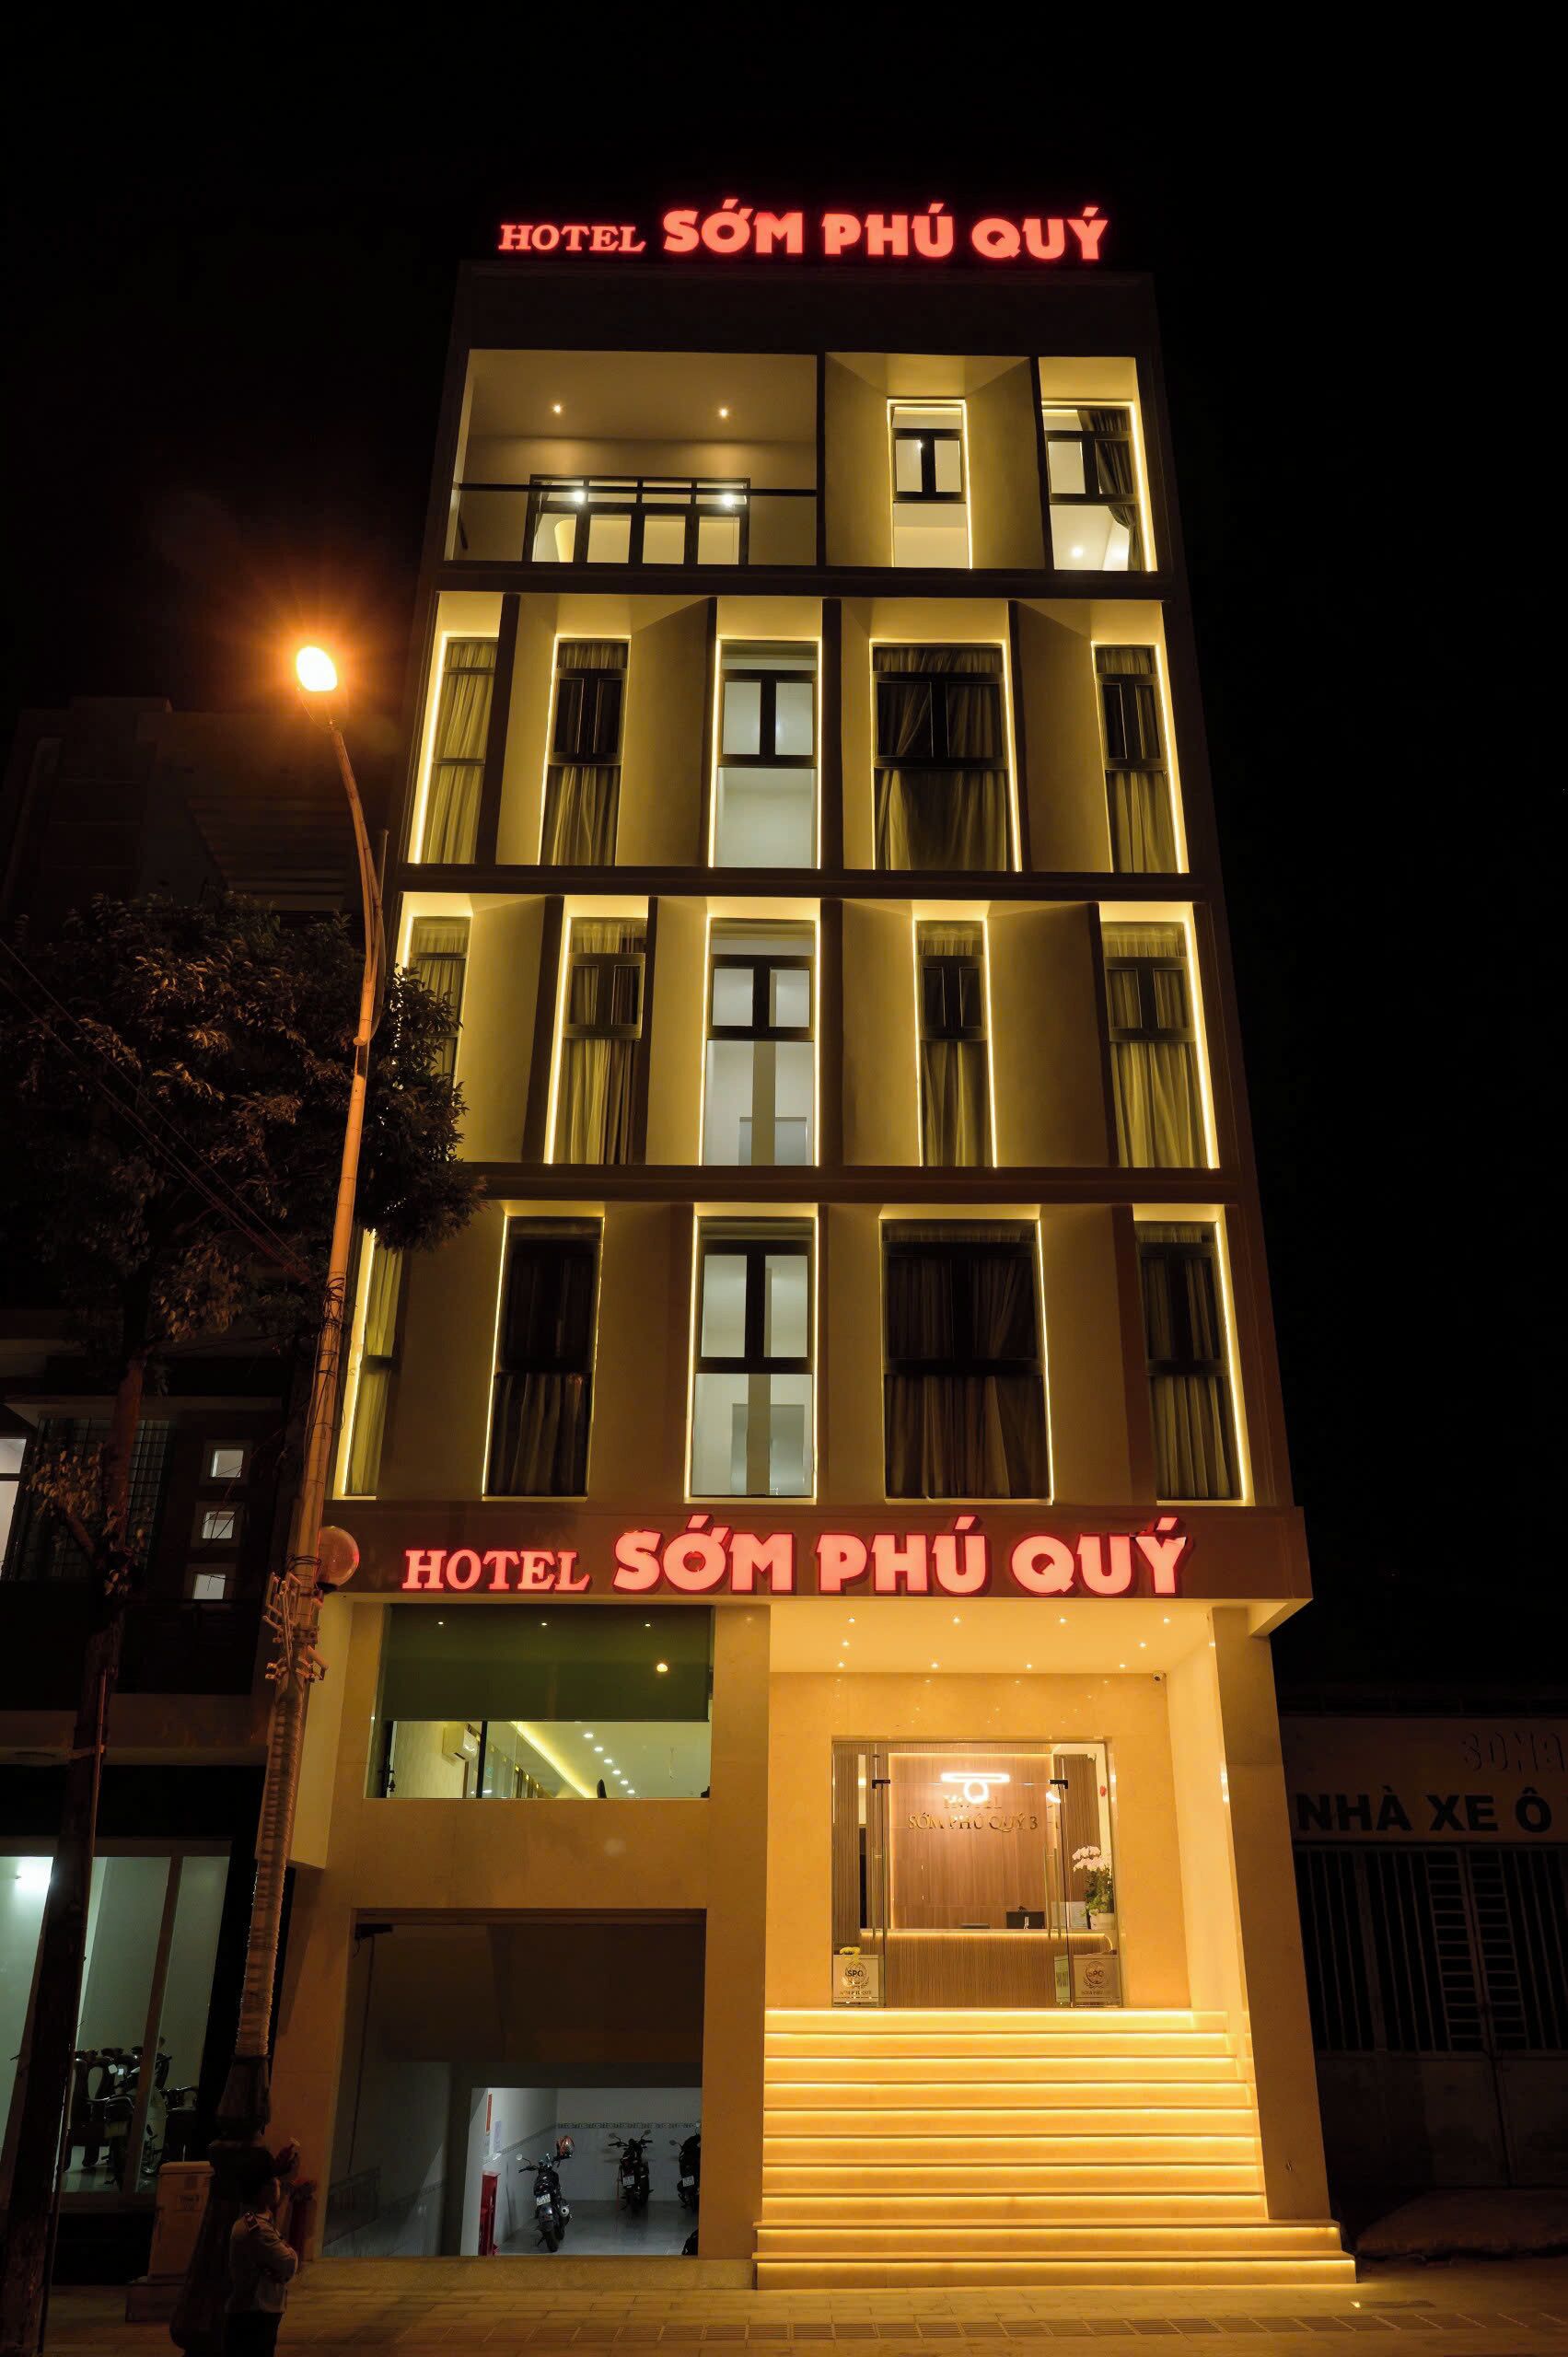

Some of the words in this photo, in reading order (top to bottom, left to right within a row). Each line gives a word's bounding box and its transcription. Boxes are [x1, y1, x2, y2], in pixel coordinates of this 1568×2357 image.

[498, 224, 646, 252] HOTEL
[662, 198, 804, 255] SỚM
[820, 202, 955, 259] PHÚ
[970, 205, 1109, 261] QUÝ
[401, 1549, 591, 1592] HOTEL
[611, 1515, 795, 1593] SỚM
[816, 1515, 988, 1595] PHÚ
[1009, 1516, 1188, 1596] QUÝ
[1295, 1785, 1413, 1831] NHÀ
[1426, 1794, 1499, 1831] XE
[1515, 1786, 1553, 1833] Ô
